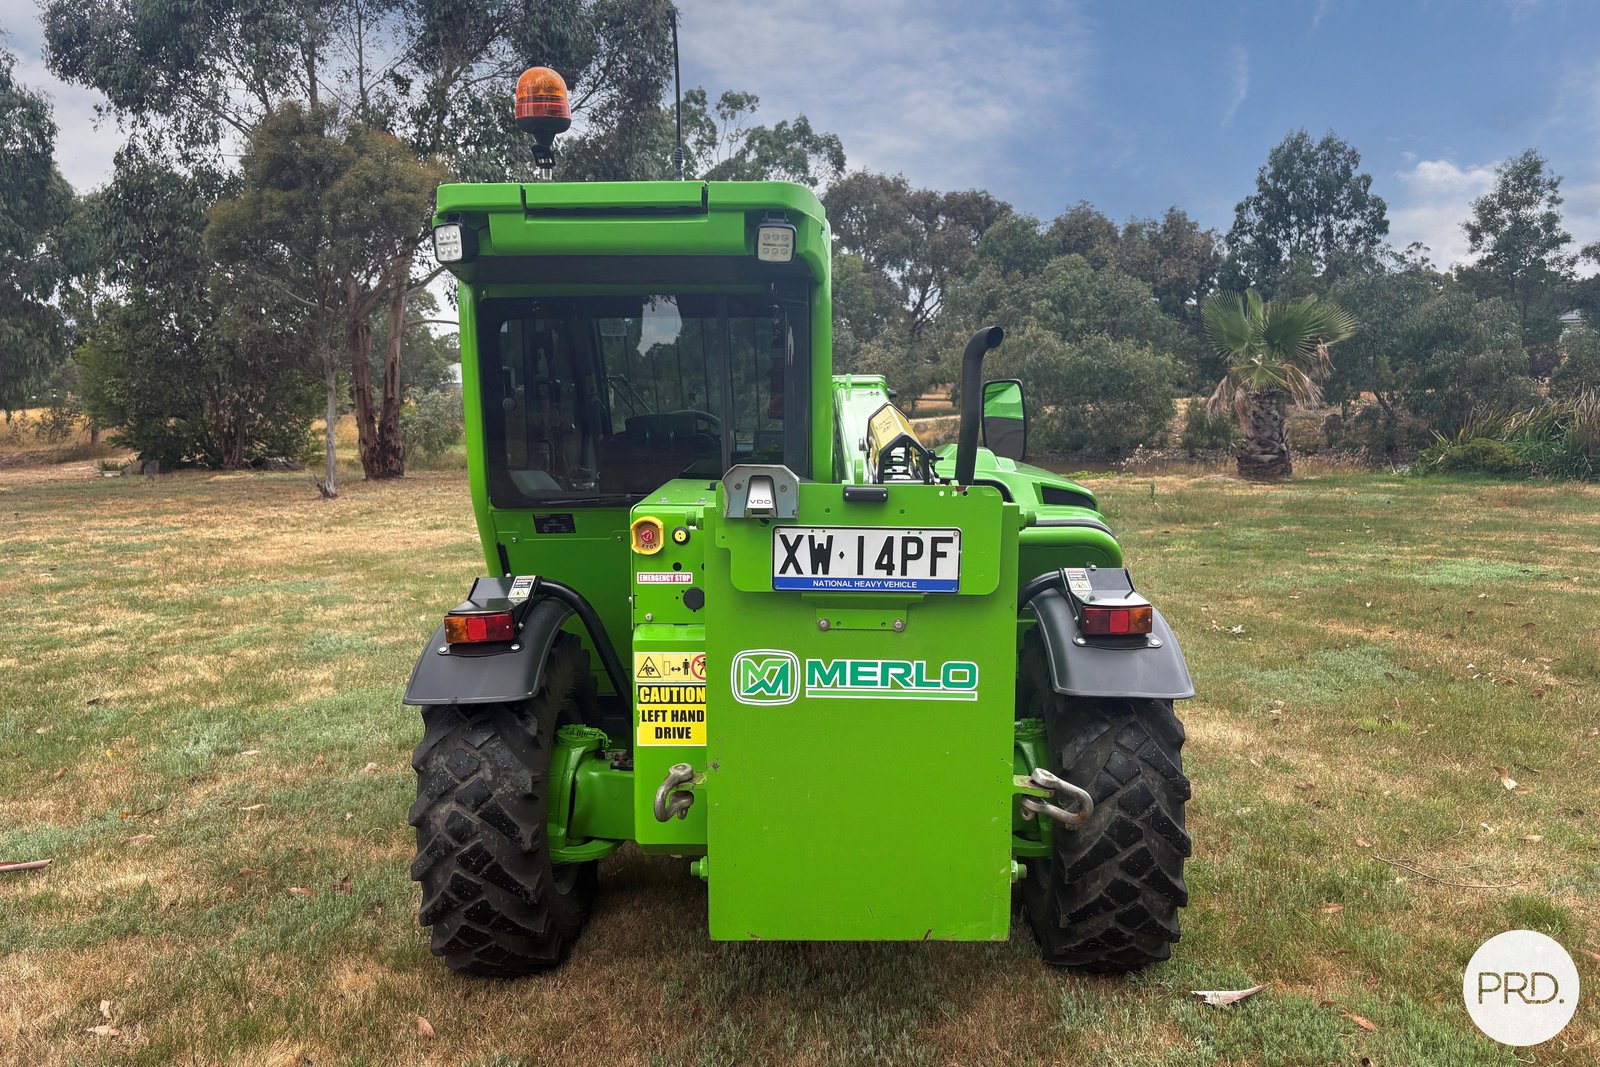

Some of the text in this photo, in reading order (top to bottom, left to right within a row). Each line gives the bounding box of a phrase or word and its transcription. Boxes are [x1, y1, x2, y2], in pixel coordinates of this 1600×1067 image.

[639, 574, 691, 582] EMERGENCY STOP
[812, 579, 917, 589] NATIONAL HEAVY VEHICLE
[806, 659, 978, 690] MERLO
[639, 686, 706, 703] CAUTION
[641, 709, 705, 723] LEFT HAND
[655, 726, 692, 740] DRIVE
